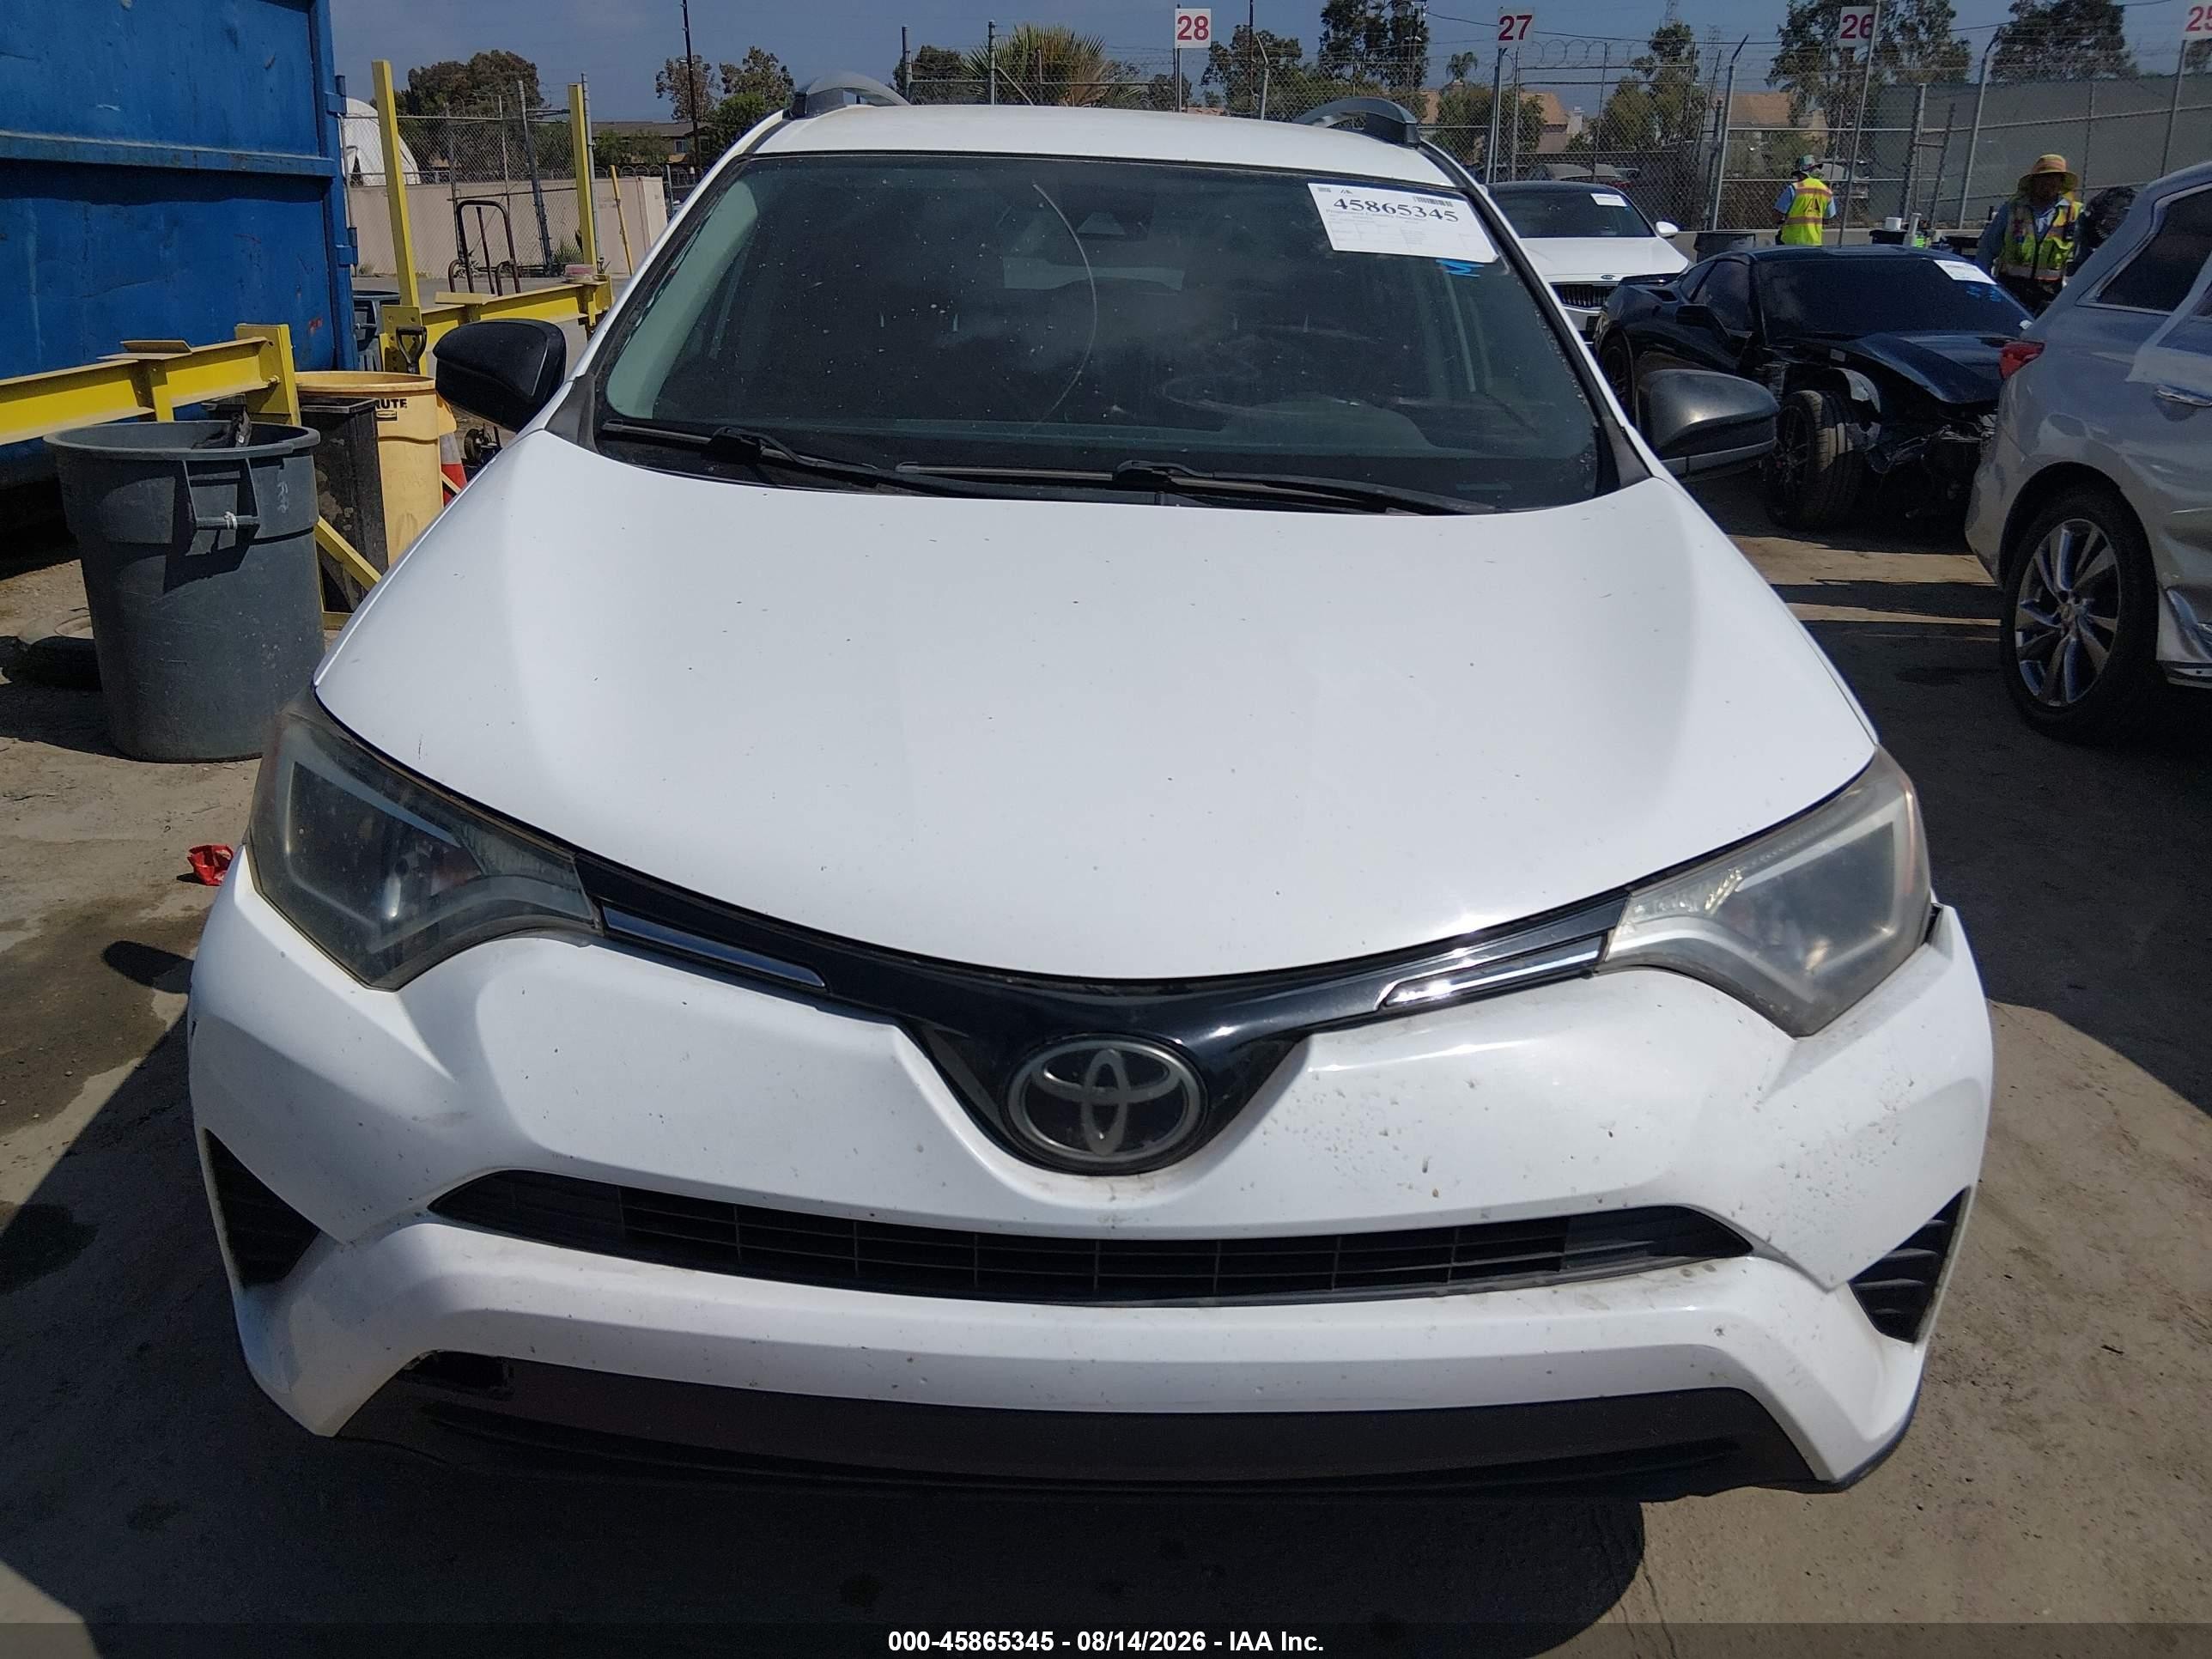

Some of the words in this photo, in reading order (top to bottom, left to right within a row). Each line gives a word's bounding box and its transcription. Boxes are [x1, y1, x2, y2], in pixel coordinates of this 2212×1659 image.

[1177, 15, 1209, 40] 28
[1498, 15, 1533, 40] 27
[1840, 14, 1875, 39] 26
[1333, 198, 1459, 222] 45865345
